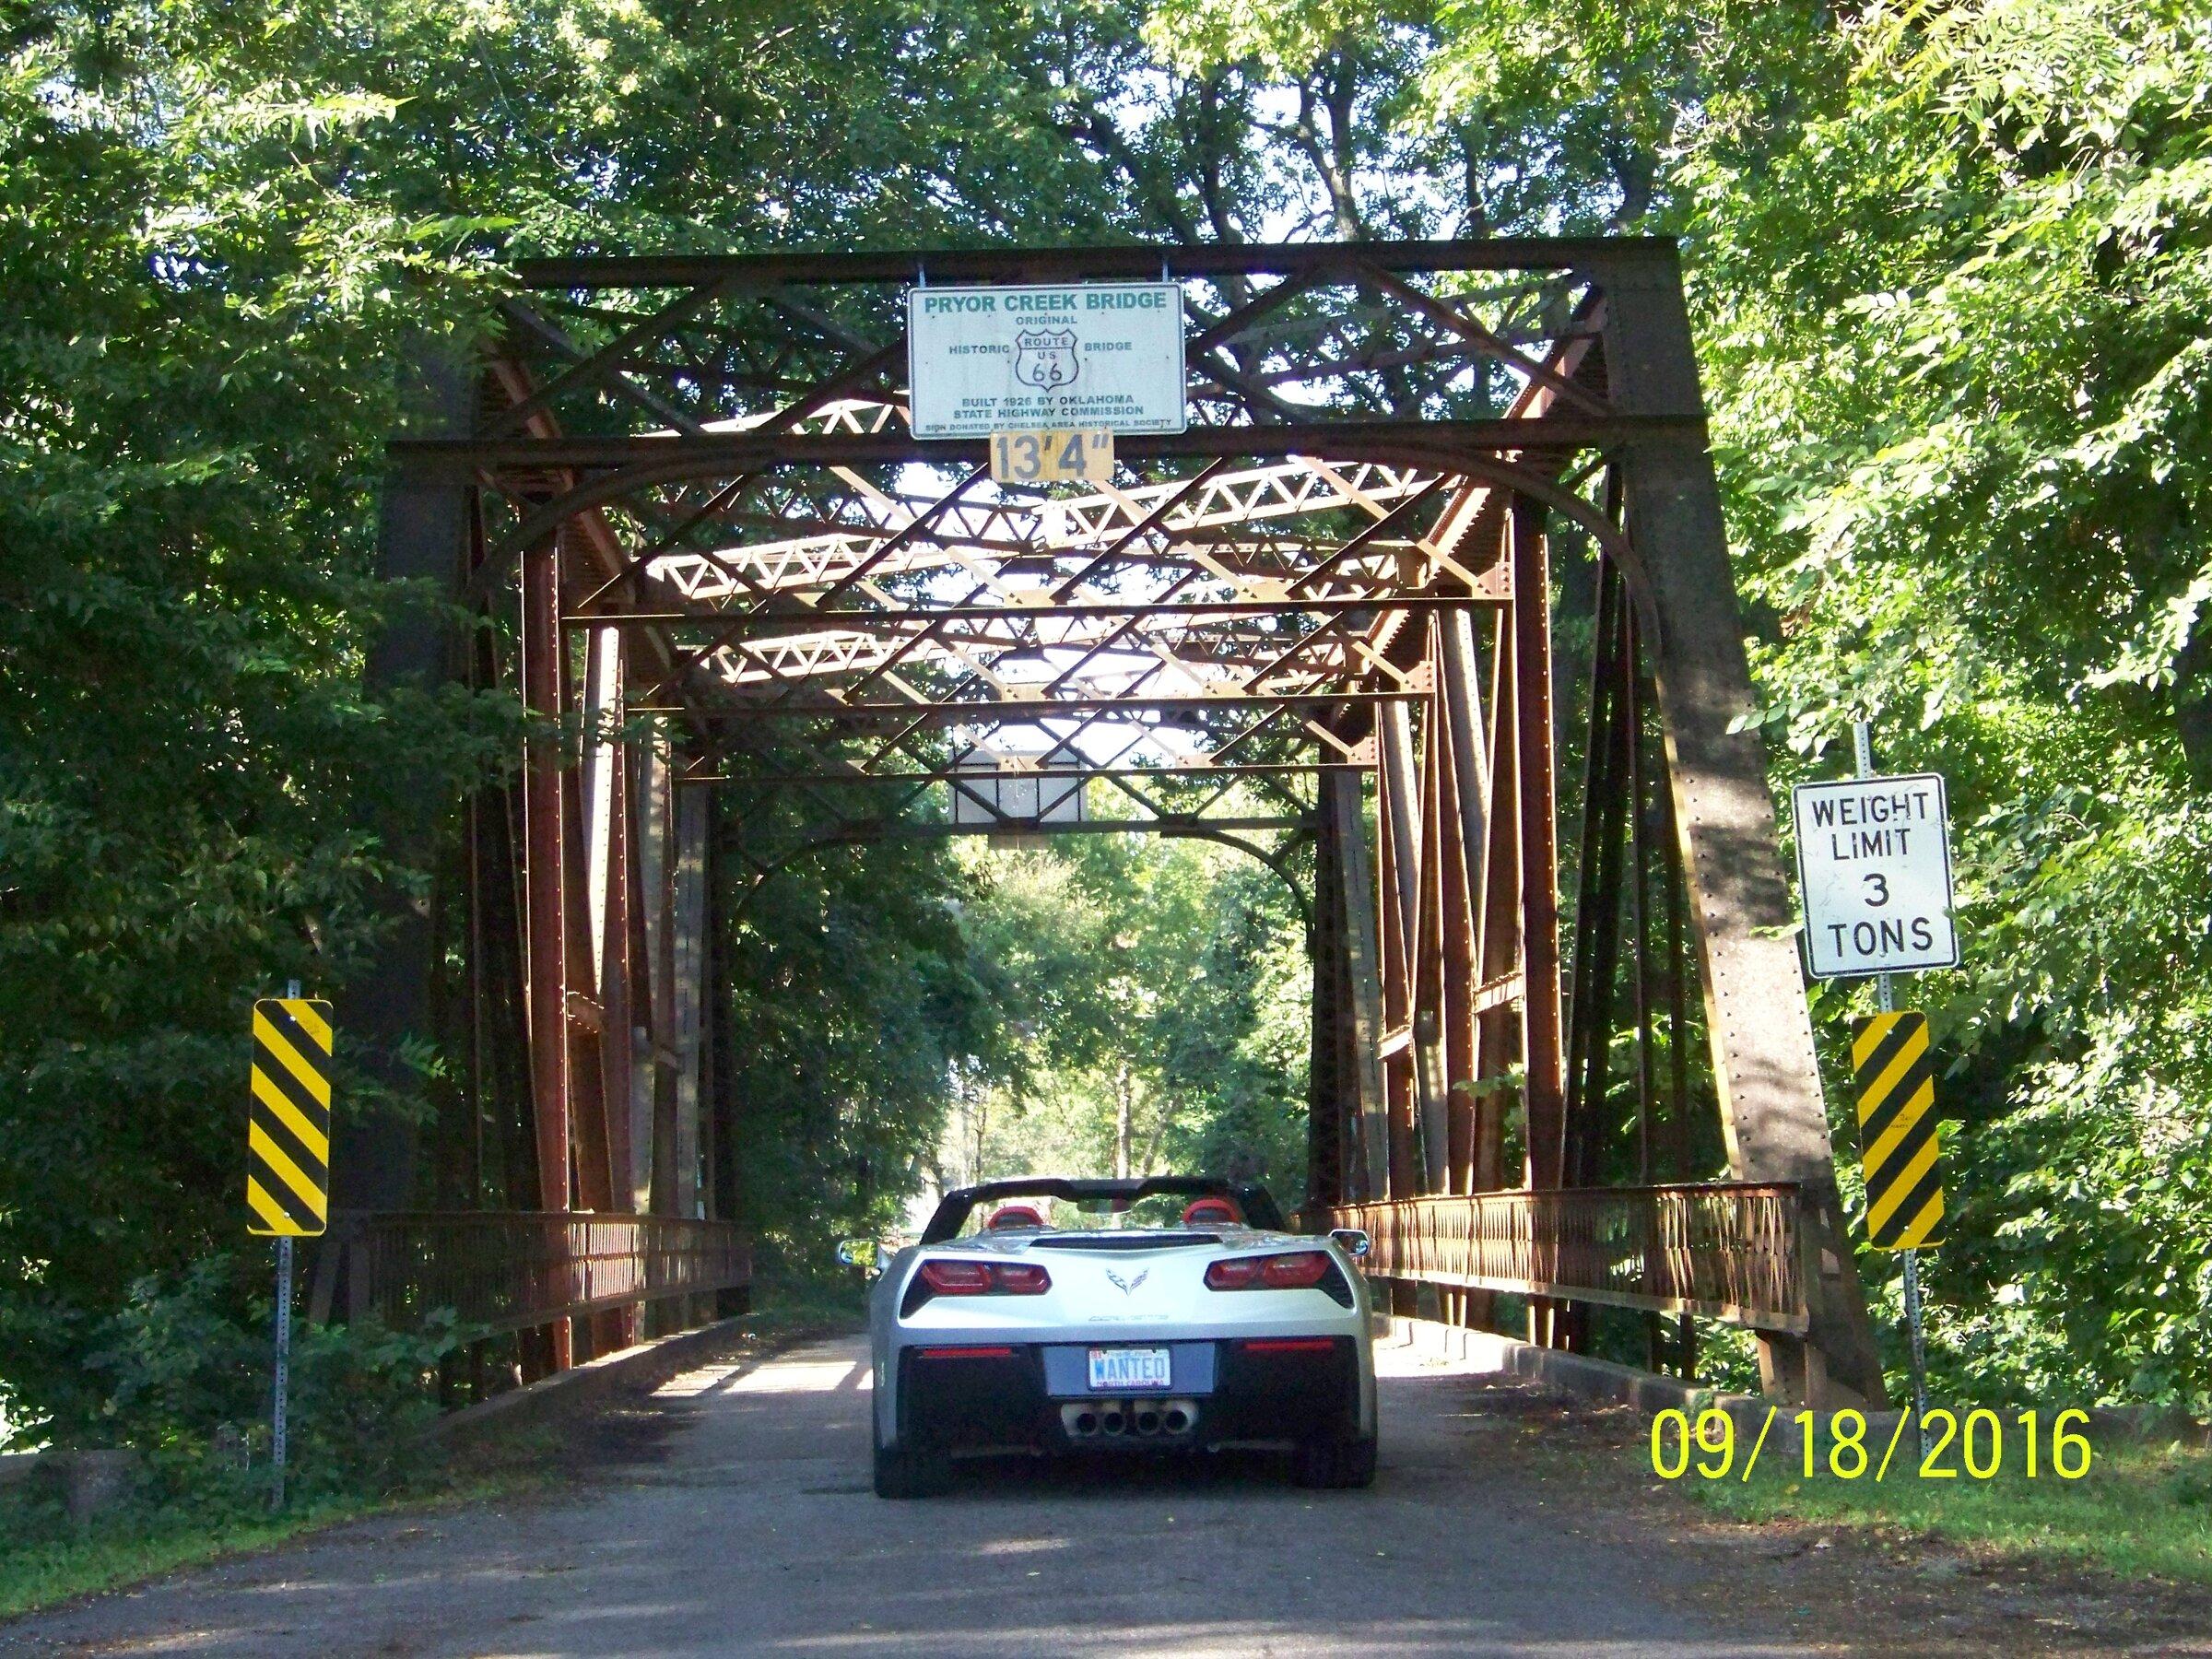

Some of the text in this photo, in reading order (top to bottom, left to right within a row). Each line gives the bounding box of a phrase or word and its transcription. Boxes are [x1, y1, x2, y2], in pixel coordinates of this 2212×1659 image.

[924, 291, 1167, 313] PRYOR CREEK BRIDGE
[1016, 314, 1077, 325] ORIGINAL
[1024, 335, 1069, 347] ROUTE
[1084, 341, 1132, 352] BRIDGE
[949, 344, 1010, 355] HISTORIC
[1037, 350, 1056, 360] US
[1031, 362, 1062, 382] 66
[962, 394, 1135, 407] BUILT 1926 BY OKLAHOMA
[953, 406, 1145, 419] STATE HIGHWAY COMMISSION
[1007, 421, 1049, 429] CHELSEA
[1134, 418, 1172, 427] SOCIETY
[1812, 792, 1929, 829] WEIGHT
[1831, 828, 1911, 861] LIMIT
[1863, 873, 1890, 908] 3
[1827, 916, 1934, 959] TONS
[1094, 1358, 1165, 1380] WANTED
